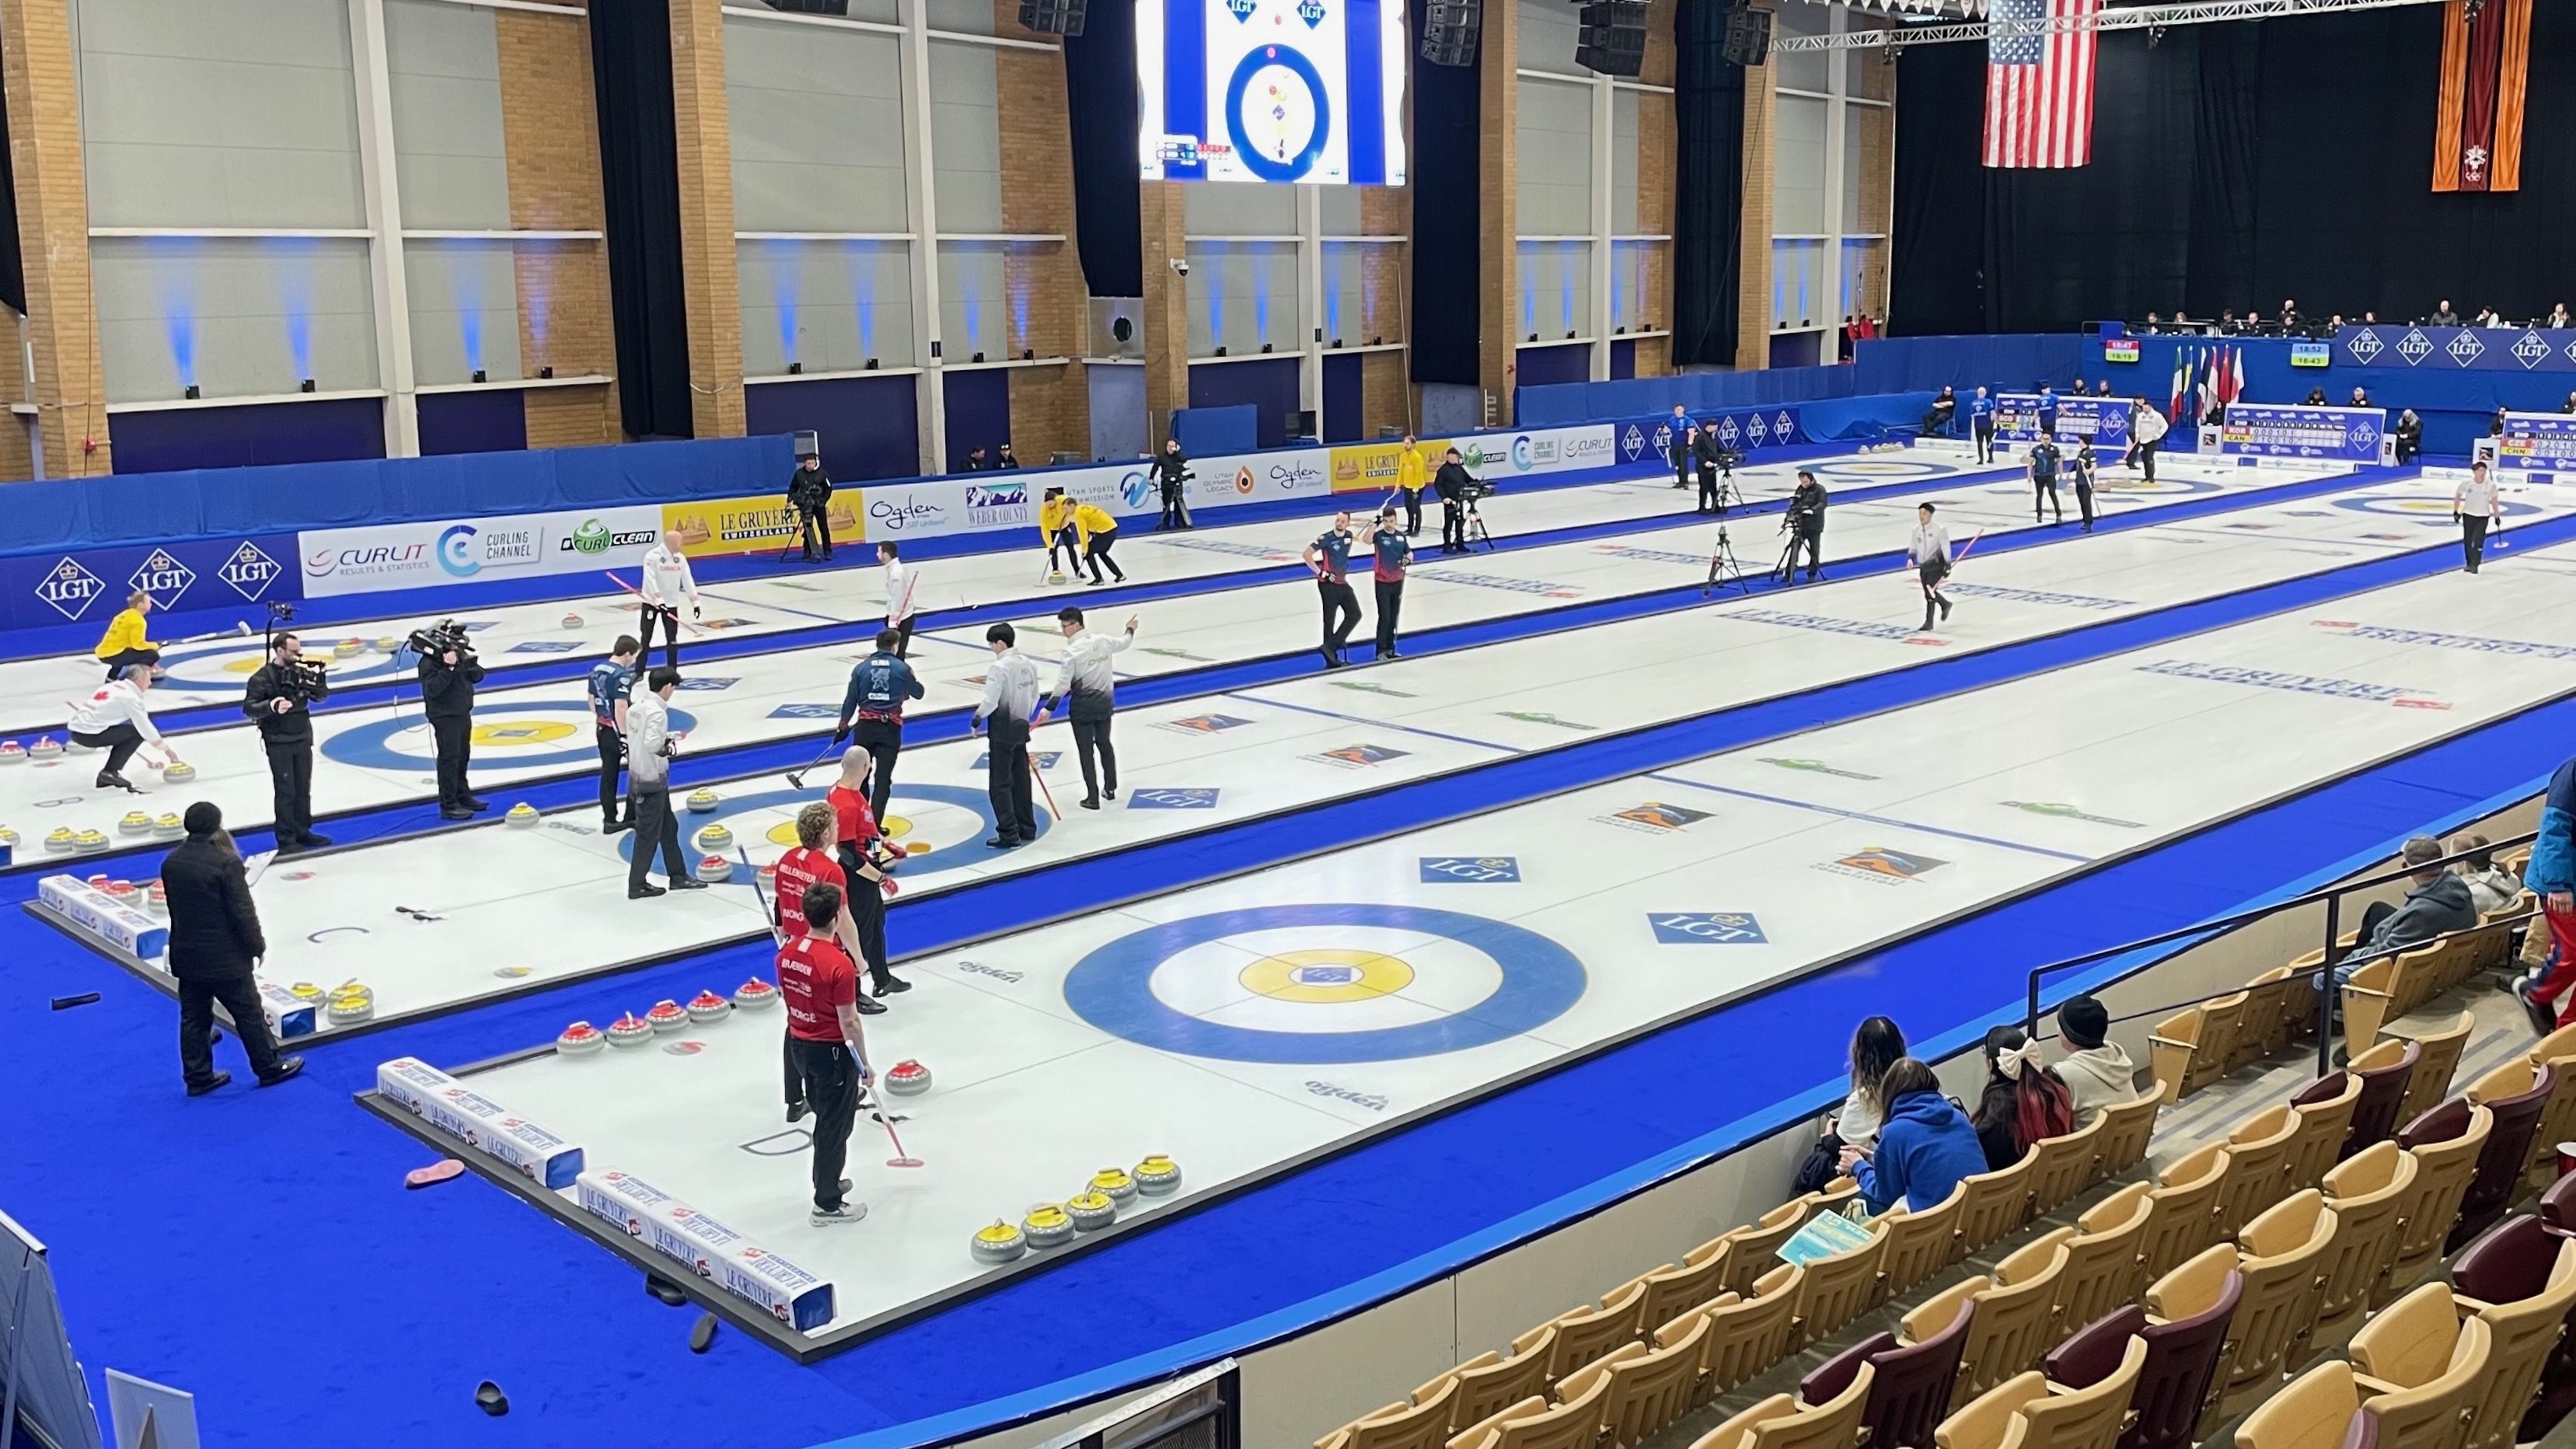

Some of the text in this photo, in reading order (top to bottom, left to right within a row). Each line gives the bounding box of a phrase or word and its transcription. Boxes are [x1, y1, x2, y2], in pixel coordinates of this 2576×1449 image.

[2354, 340, 2379, 353] LGT
[2402, 341, 2429, 354] LGT
[2452, 342, 2480, 355] LGT
[2517, 344, 2546, 357] LGT
[1750, 426, 1764, 436] LGT
[1777, 423, 1790, 434] LGT
[2105, 420, 2123, 428] LGT
[1722, 429, 1736, 439] LGT
[2353, 431, 2375, 442] LGT
[1579, 438, 1613, 451] CURLIT
[1626, 438, 1642, 449] LGT
[1365, 454, 1399, 470] LE GRUY
[1484, 452, 1506, 463] CLEAN
[1270, 460, 1321, 489] Ogden
[871, 494, 944, 529] Ogden
[969, 506, 1029, 525] WEBER COUNTY
[720, 513, 736, 531] LE
[487, 531, 529, 546] CURLING
[613, 532, 654, 545] CLEAN
[724, 527, 794, 539] SWITZERLAND
[339, 543, 428, 566] CURLIT
[487, 545, 531, 560] CHANNEL
[229, 561, 272, 583] LGT
[340, 566, 375, 576] RESULTS
[386, 561, 430, 571] STATISTICS
[140, 569, 187, 592] LGT
[47, 578, 95, 602] LGT
[1137, 790, 1211, 807] LGT
[1425, 858, 1513, 883] LGT
[782, 908, 805, 922] NORG
[1658, 915, 1757, 942] LGT
[790, 1006, 817, 1023] NORGE
[1304, 1080, 1386, 1112] ogden
[587, 1188, 595, 1204] LE
[654, 1226, 663, 1244] LE
[726, 1268, 736, 1287] LE
